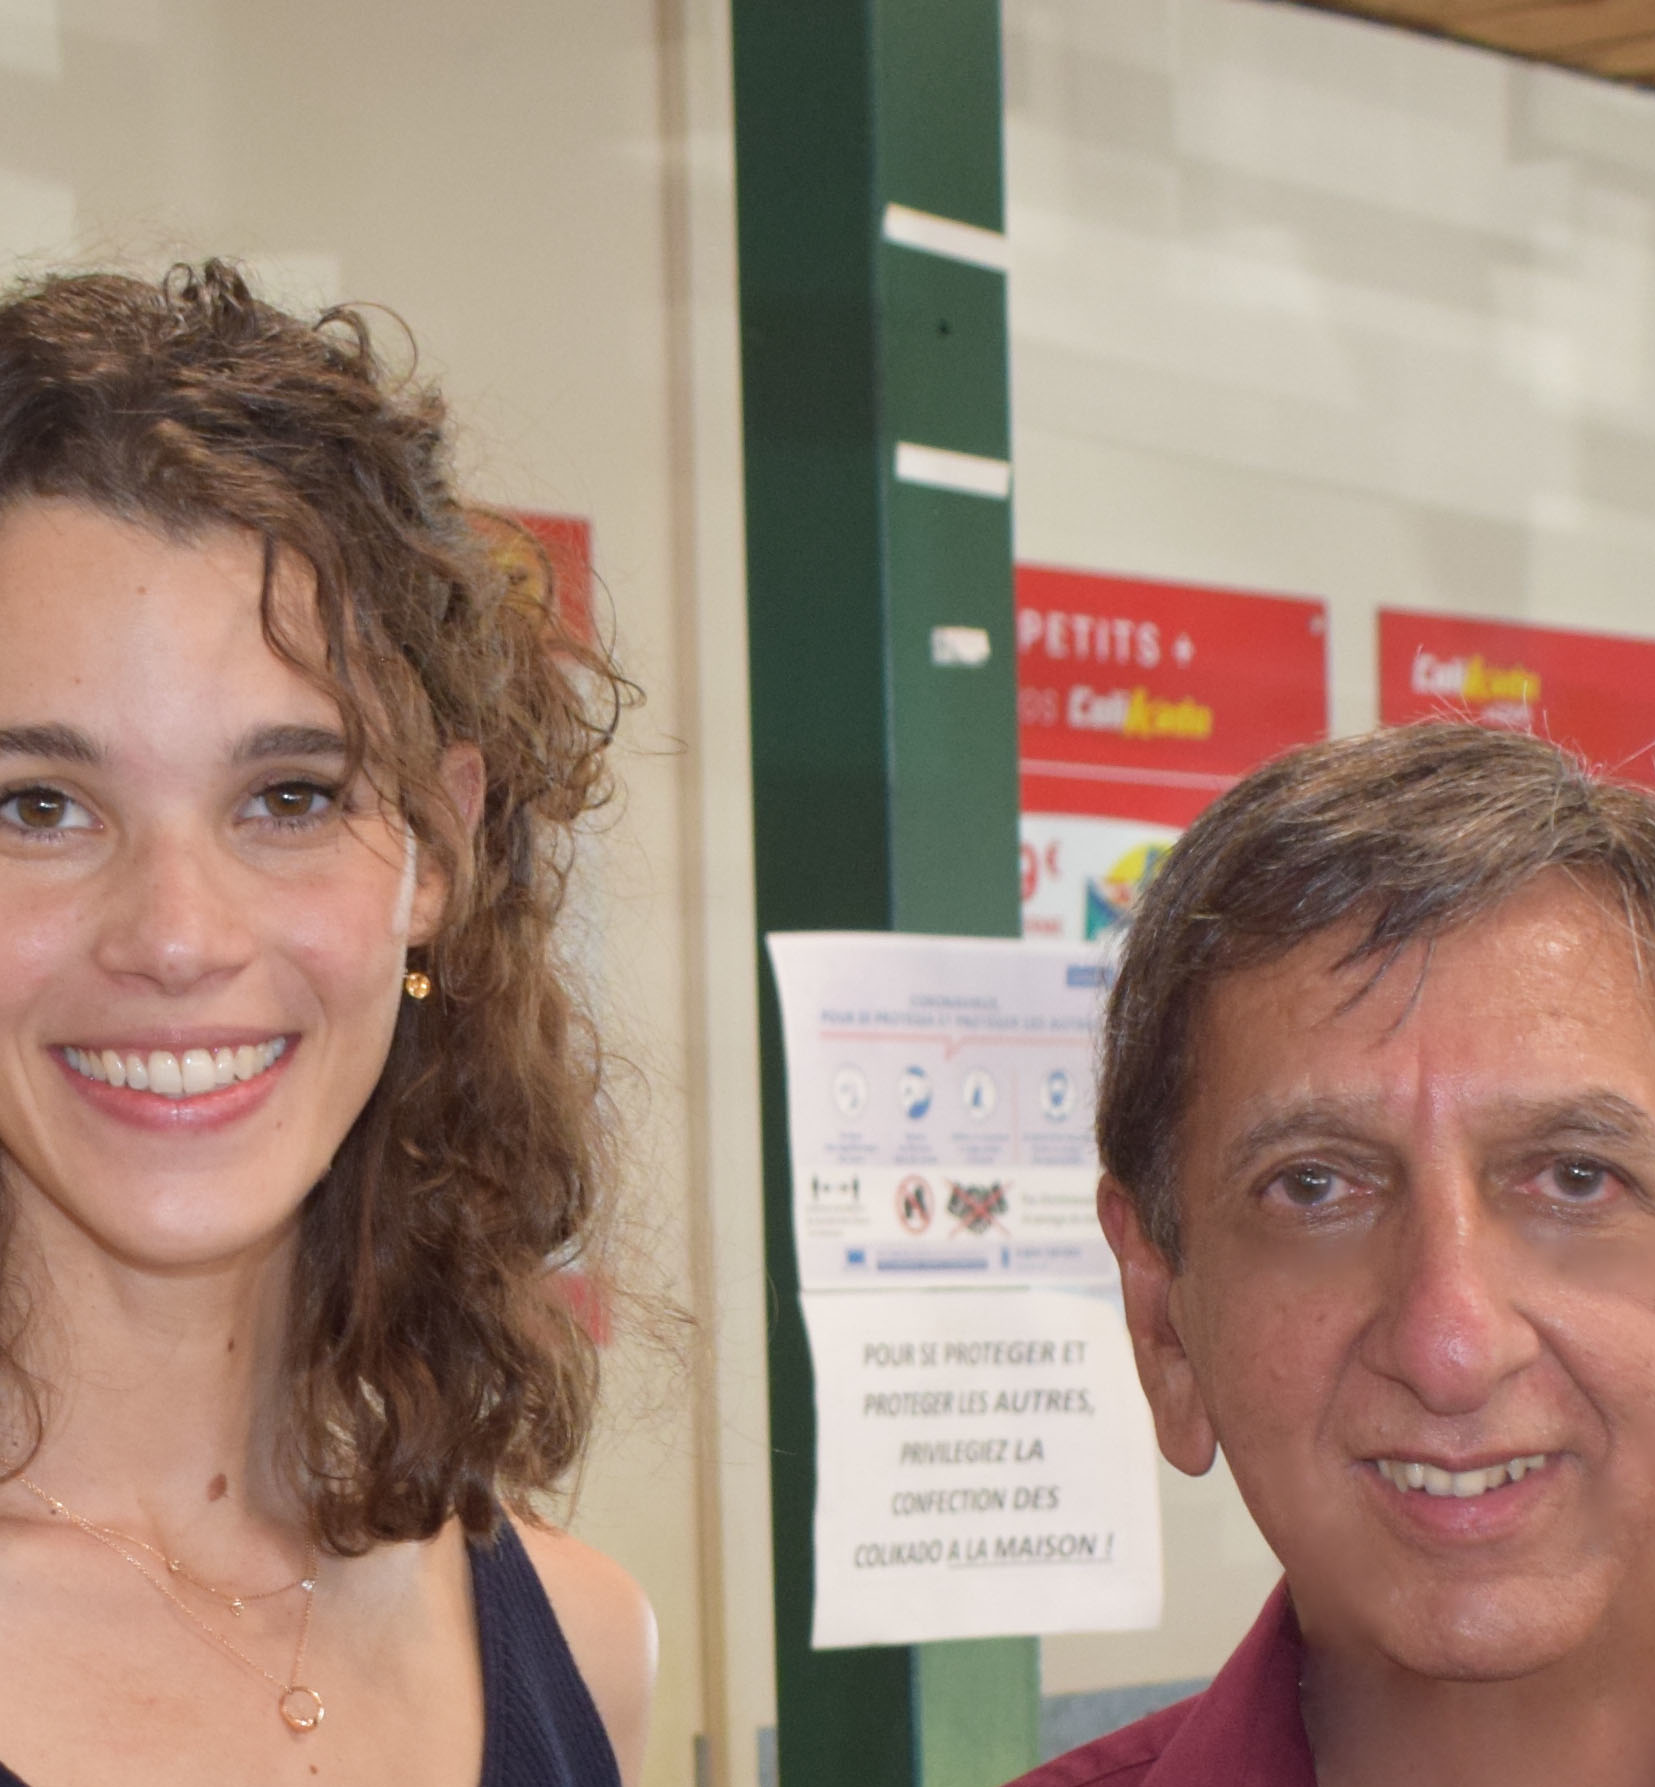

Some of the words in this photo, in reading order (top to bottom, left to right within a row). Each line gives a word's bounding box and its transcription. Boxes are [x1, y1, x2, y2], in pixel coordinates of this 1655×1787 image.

[1017, 608, 1162, 669] PETITS
[863, 1341, 915, 1367] POUR
[920, 1342, 939, 1366] SE
[944, 1340, 1056, 1366] PROTEGER
[1061, 1340, 1087, 1365] ET
[863, 1391, 954, 1416] PROTEGER
[958, 1390, 989, 1415] LES
[994, 1388, 1096, 1416] AUTRES,
[900, 1439, 1009, 1465] PRIVILEGIEZ
[1013, 1437, 1045, 1463] LA
[891, 1487, 1006, 1516] CONFECTION
[1013, 1485, 1060, 1511] DES
[853, 1538, 943, 1569] COLIKADO
[947, 1537, 962, 1561] A
[966, 1536, 989, 1561] LA
[994, 1533, 1097, 1559] MAISON
